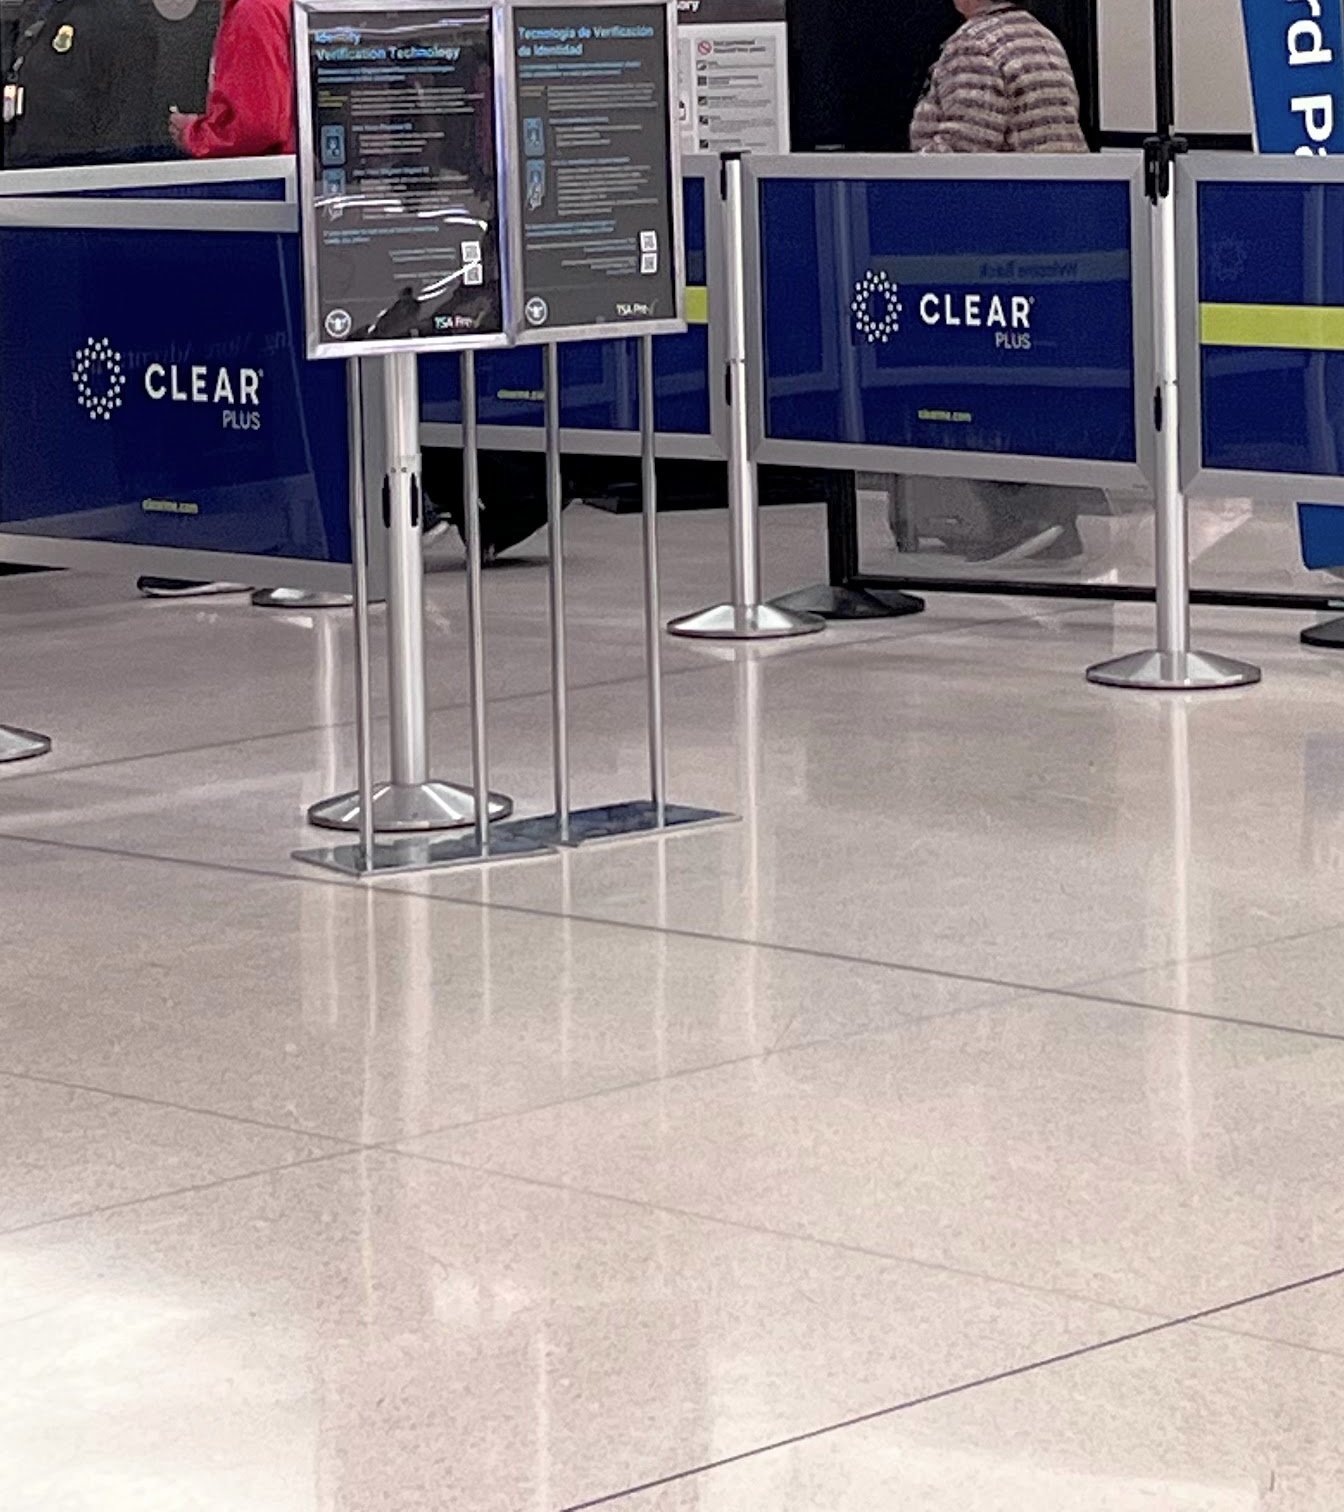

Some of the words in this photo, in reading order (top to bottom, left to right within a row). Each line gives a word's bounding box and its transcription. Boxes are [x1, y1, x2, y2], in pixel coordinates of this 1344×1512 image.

[315, 46, 387, 61] Verification
[388, 45, 461, 61] Technology
[919, 293, 1032, 329] CLEAR
[994, 332, 1032, 350] PLUS
[144, 363, 260, 405] CLEAR
[222, 410, 261, 431] PLUS
